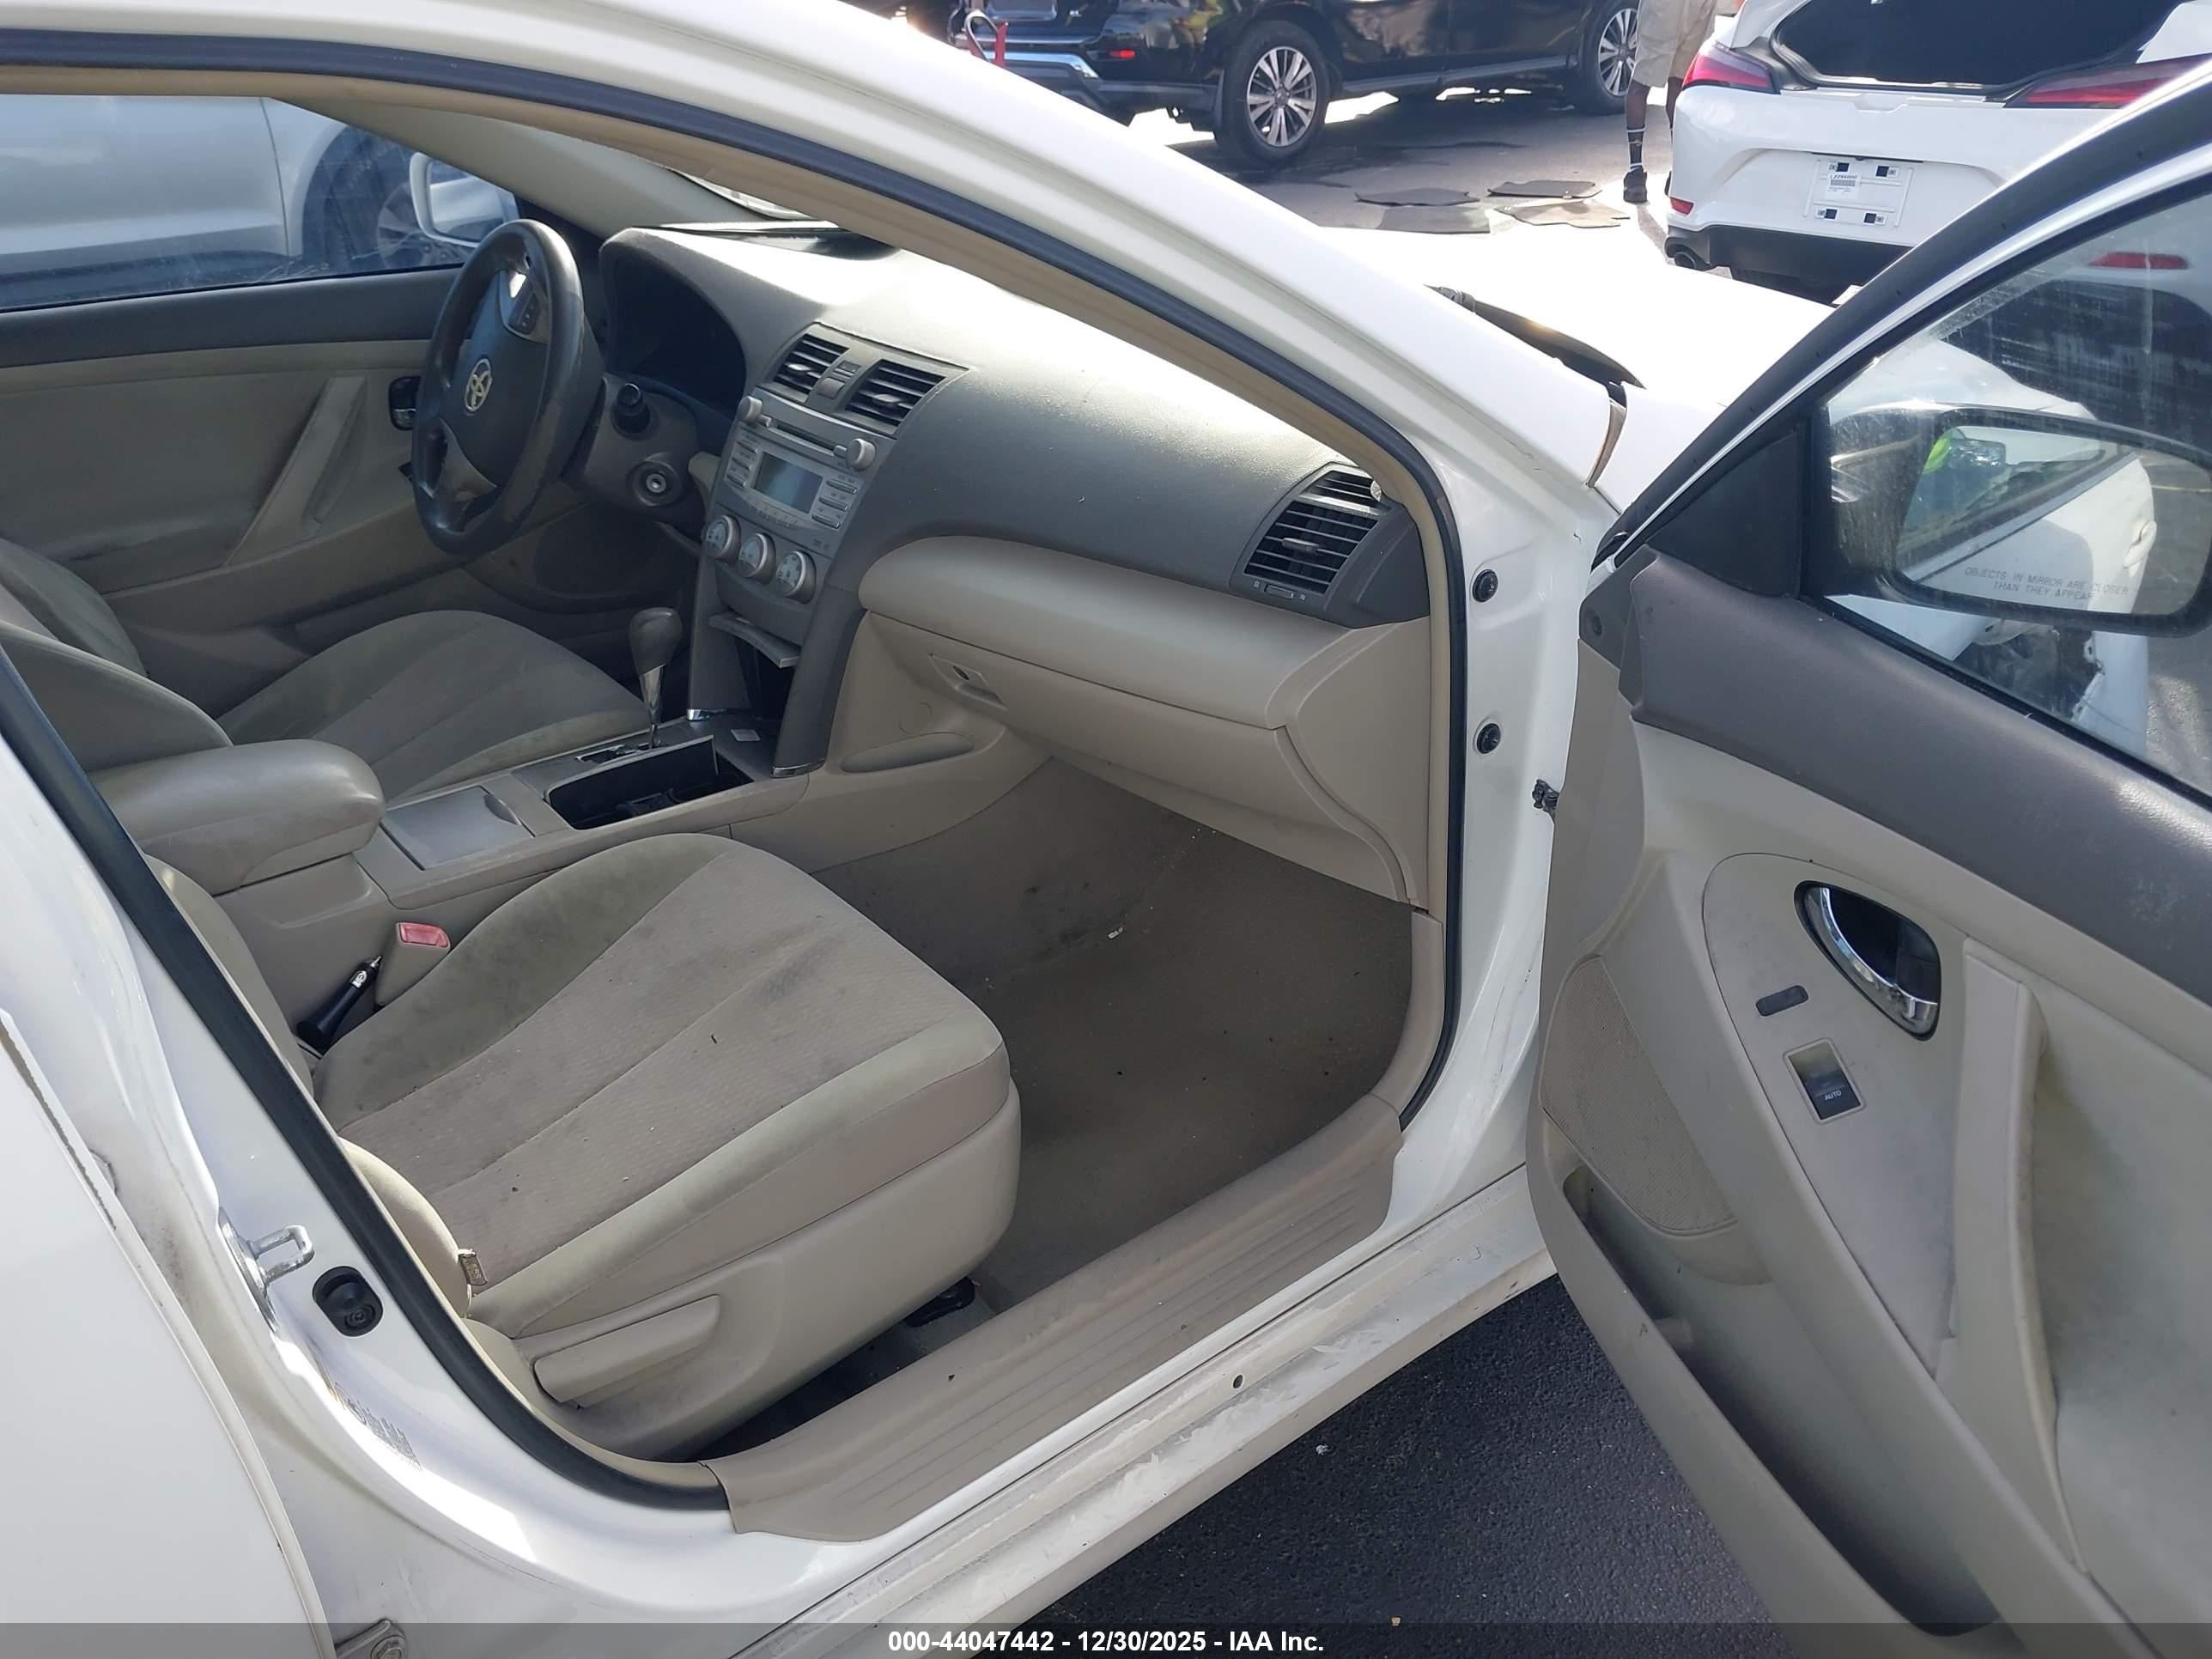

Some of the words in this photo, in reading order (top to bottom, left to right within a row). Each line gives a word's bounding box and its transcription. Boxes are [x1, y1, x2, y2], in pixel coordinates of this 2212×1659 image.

[1965, 567, 2007, 580] OBJECTS
[2013, 573, 2023, 582] IN
[2027, 574, 2063, 586] MIRROR
[2067, 580, 2086, 591] ARE
[2092, 582, 2130, 595] CLOSER
[1994, 580, 2019, 592] THAN
[2026, 585, 2050, 595] THEY
[1824, 1090, 1842, 1101] AUTO
